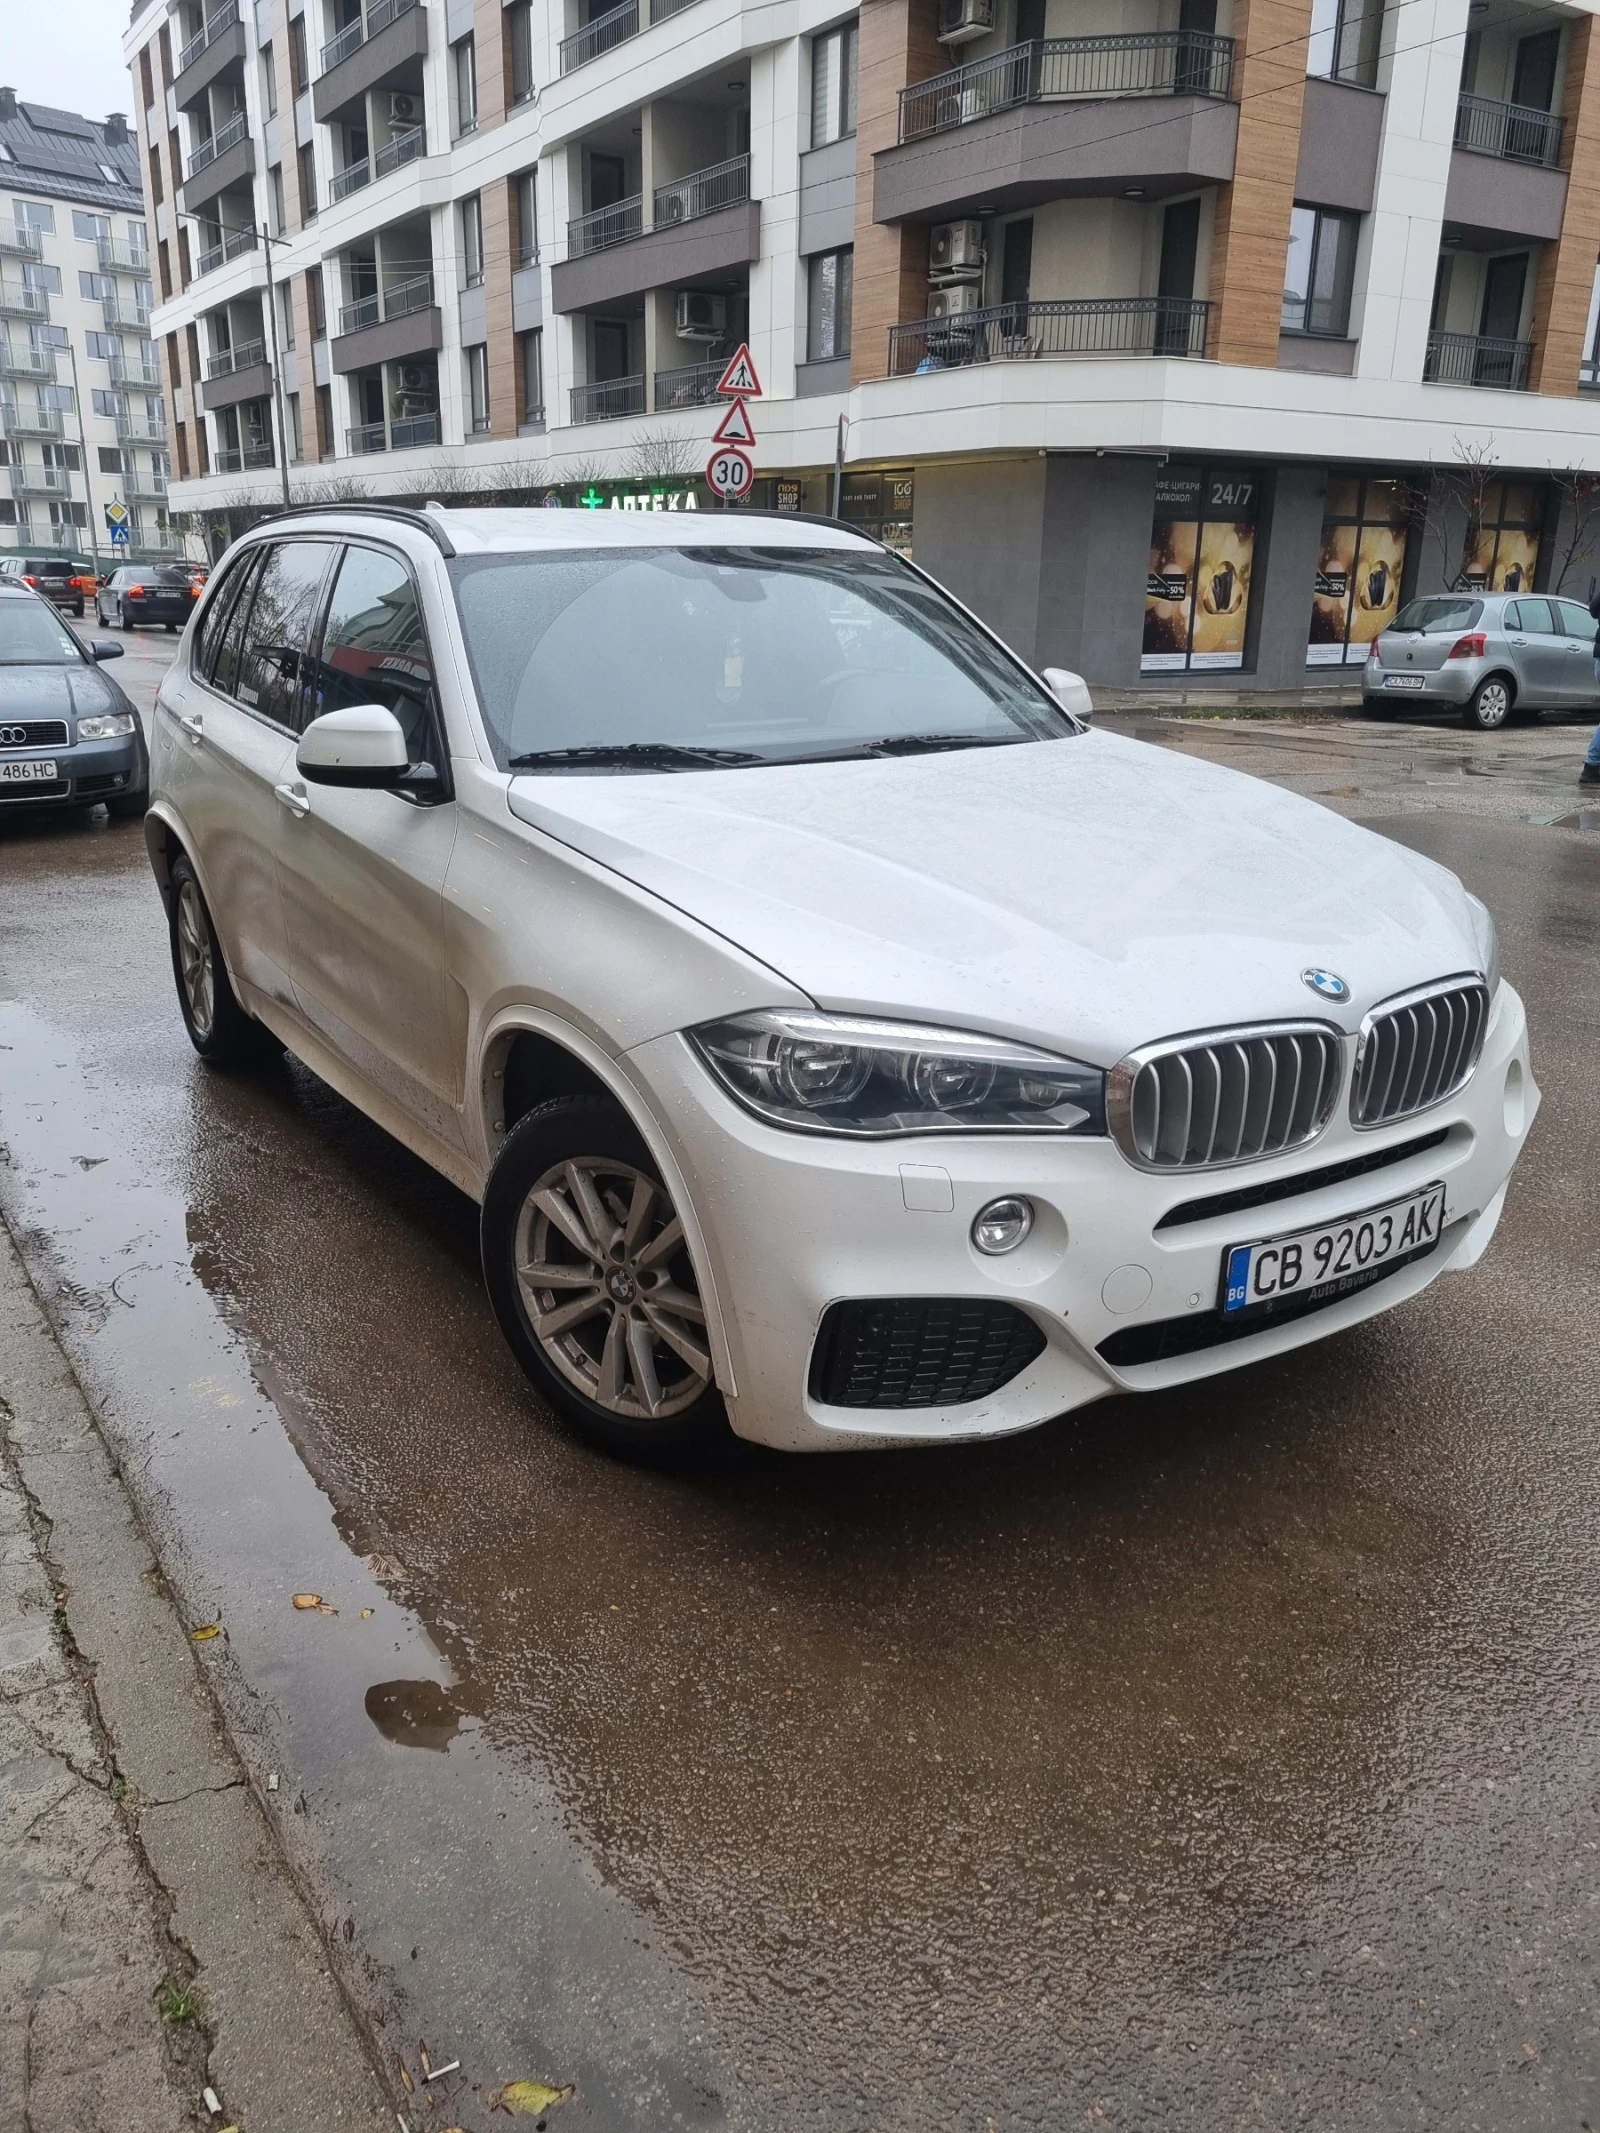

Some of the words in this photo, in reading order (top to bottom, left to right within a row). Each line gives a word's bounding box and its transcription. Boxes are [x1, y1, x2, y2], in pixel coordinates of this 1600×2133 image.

[716, 460, 743, 486] 30
[611, 491, 697, 511] АПТЕКА
[777, 493, 798, 504] SHOP
[1211, 483, 1253, 505] 24/7
[893, 499, 911, 511] SHOP
[2, 764, 31, 779] 486
[33, 763, 54, 778] HC
[1228, 1286, 1245, 1302] BG
[1253, 1244, 1303, 1296] CB
[1314, 1215, 1394, 1280] 9203
[1398, 1194, 1439, 1250] AK
[1308, 1284, 1336, 1301] Auto
[1339, 1268, 1379, 1291] Bavaria
